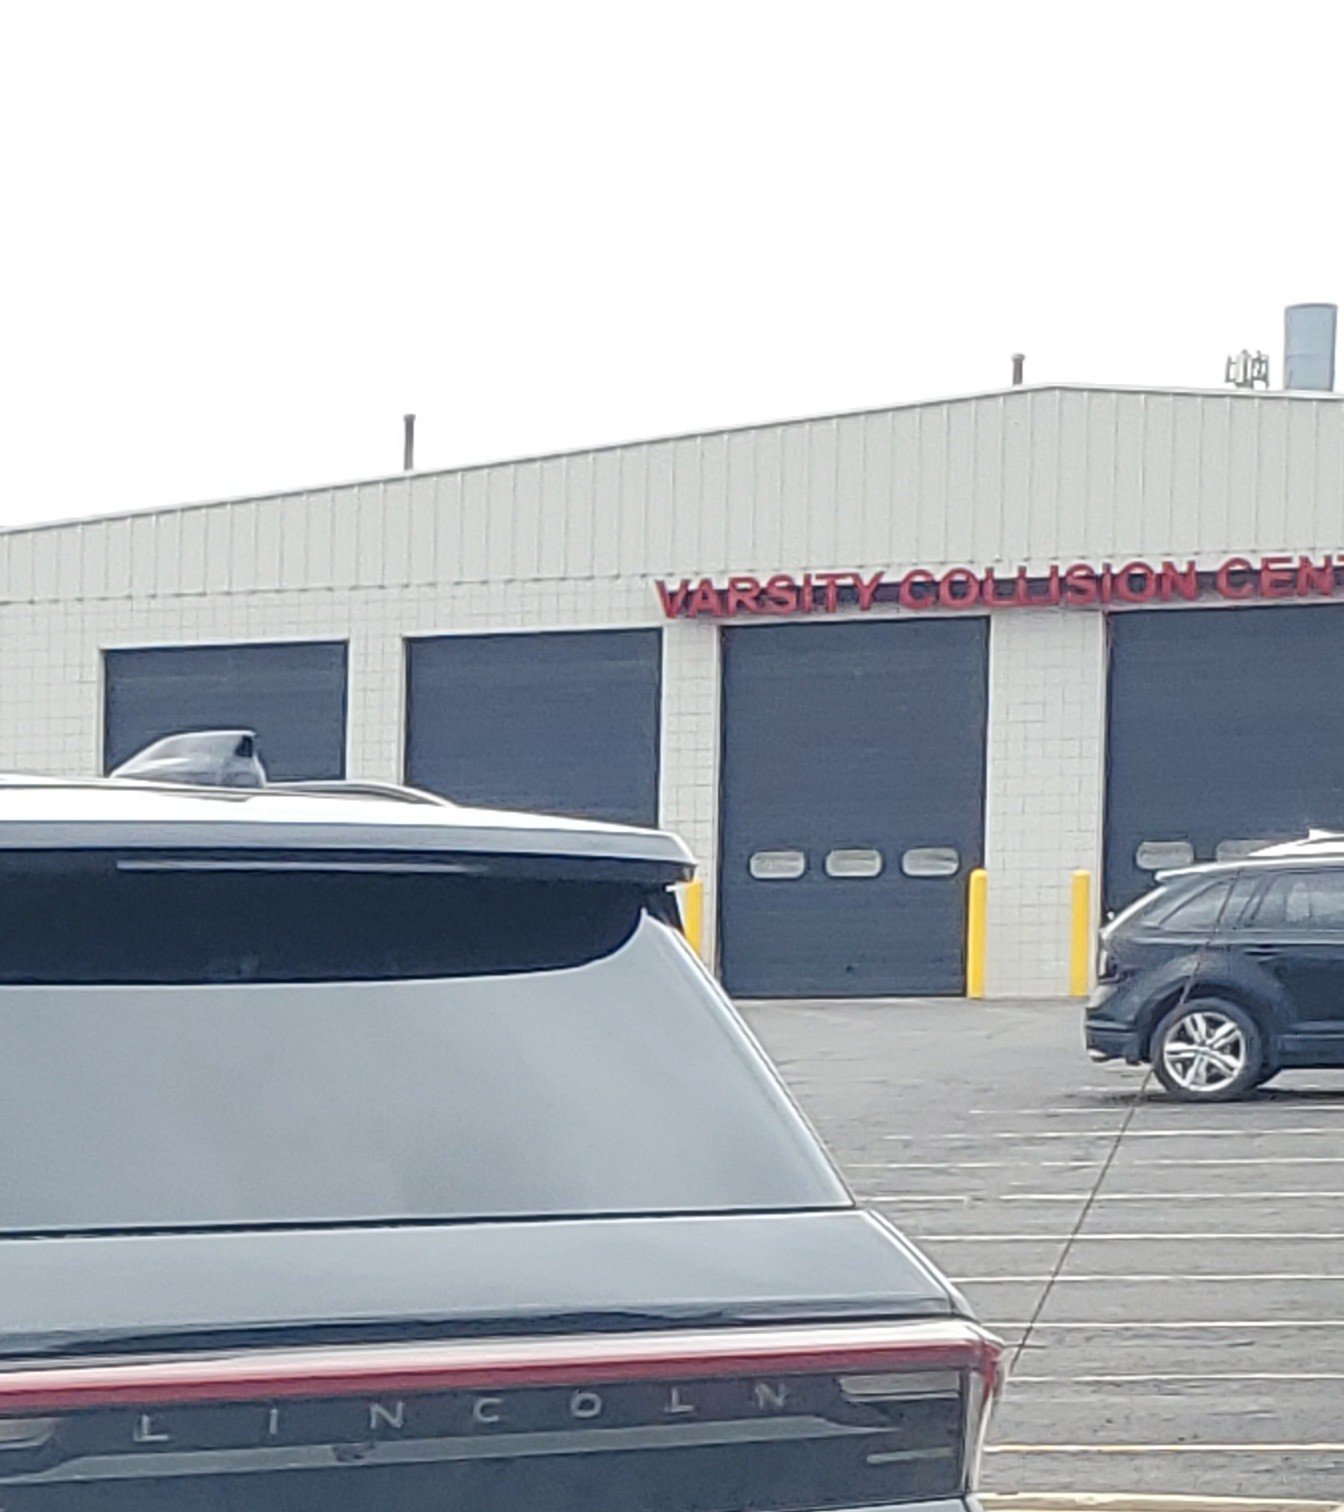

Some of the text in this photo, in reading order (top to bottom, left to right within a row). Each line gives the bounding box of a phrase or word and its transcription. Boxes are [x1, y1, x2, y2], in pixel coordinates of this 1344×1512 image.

[655, 554, 1344, 619] VARSITY COLLISION CEN
[133, 1382, 788, 1443] LINCOLN
